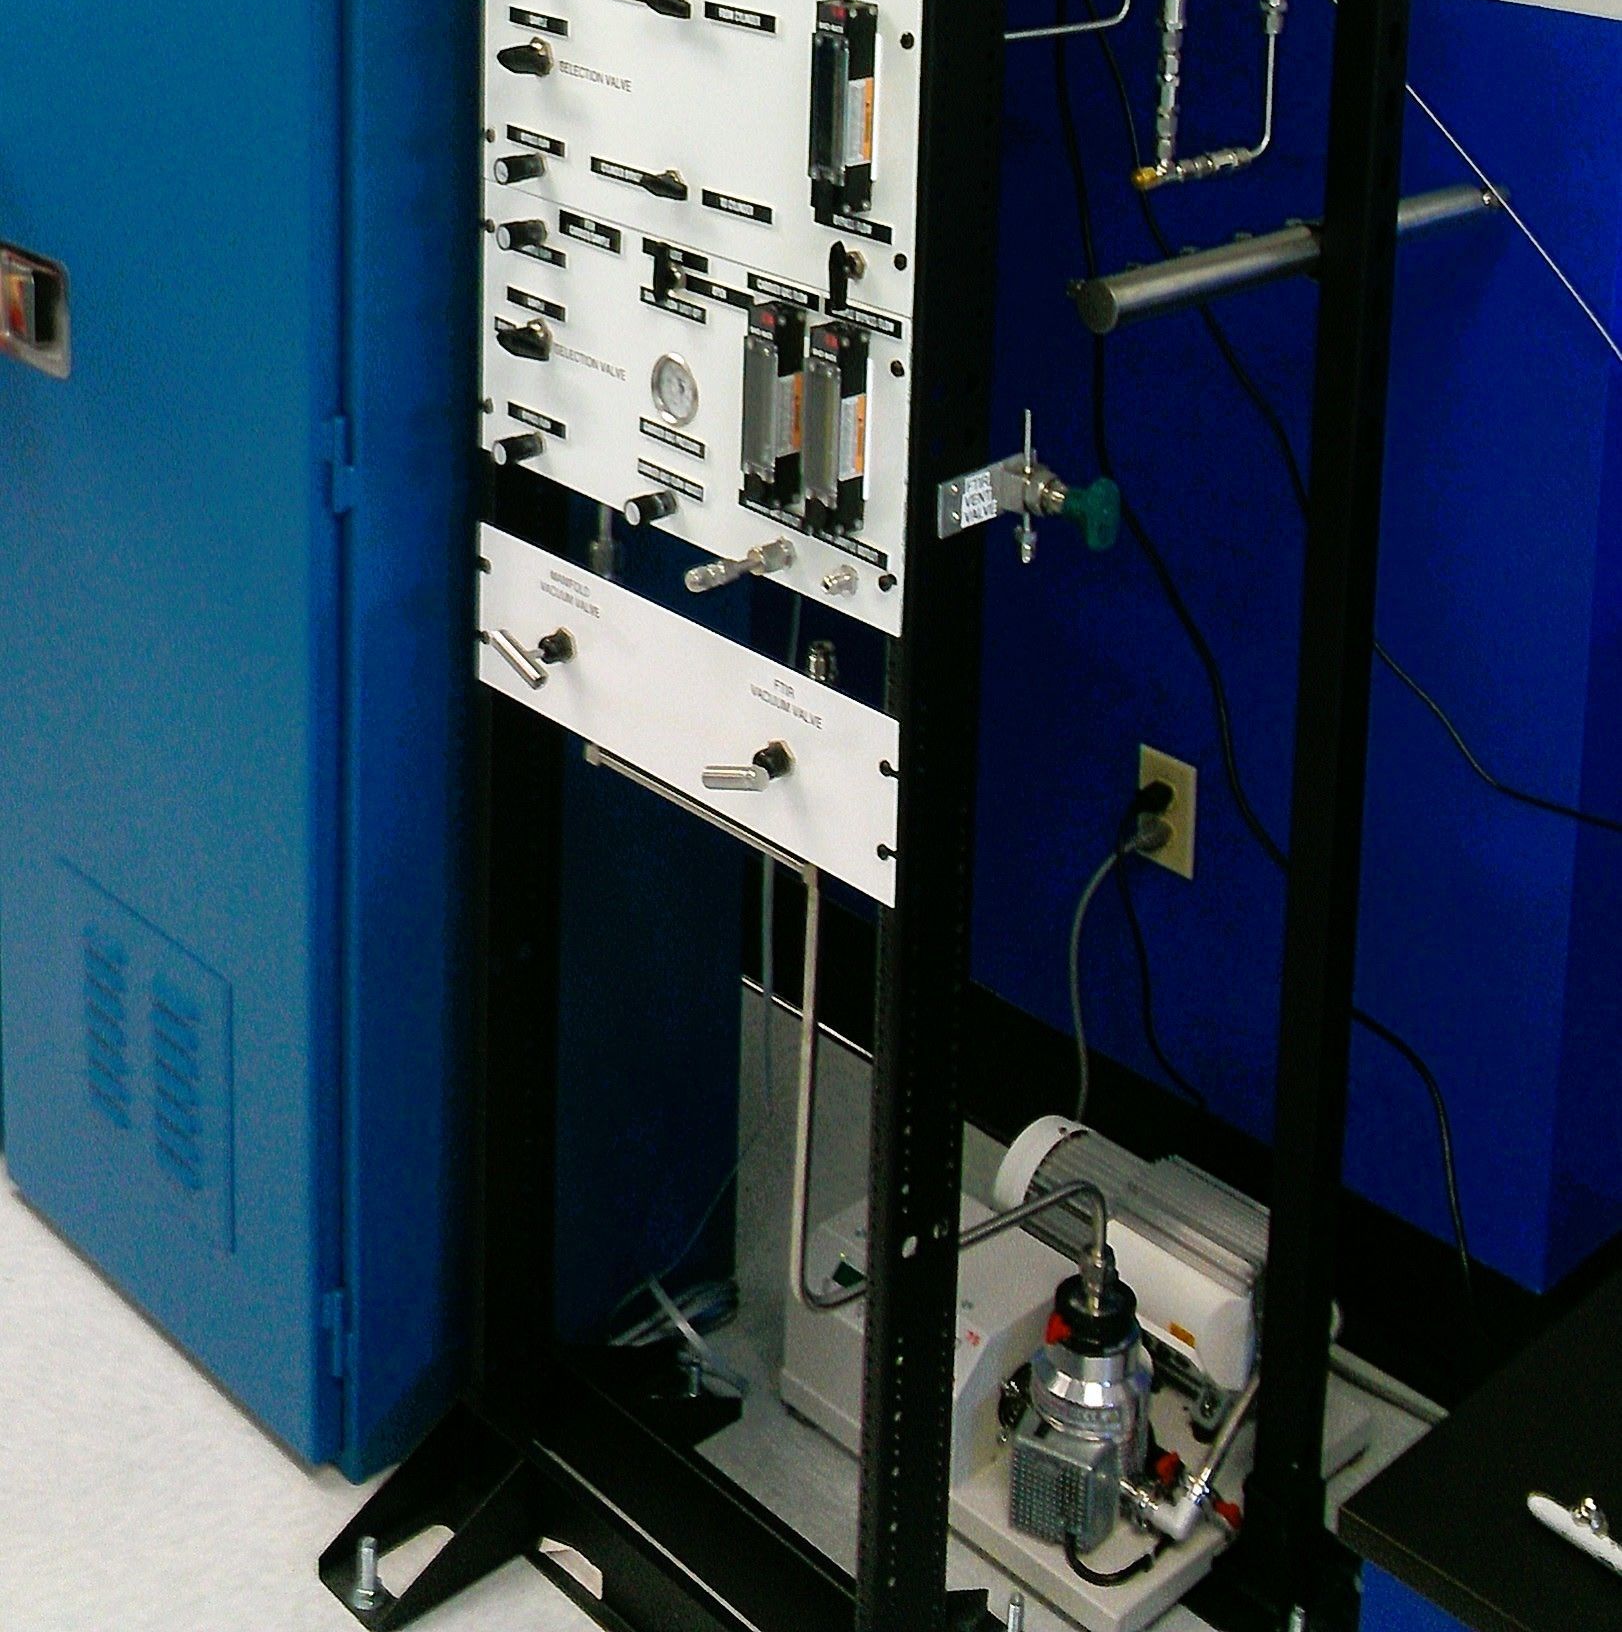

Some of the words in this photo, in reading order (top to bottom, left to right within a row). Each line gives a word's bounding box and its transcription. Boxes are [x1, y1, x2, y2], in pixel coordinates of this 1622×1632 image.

[559, 60, 604, 84] SELECTION
[605, 74, 632, 93] VALVE
[553, 341, 599, 371] SELECTION
[600, 362, 627, 382] VALVE
[574, 598, 600, 619] VALVE
[773, 678, 796, 700] FTIR
[750, 683, 790, 713] VACUUM
[791, 704, 822, 730] VALVE
